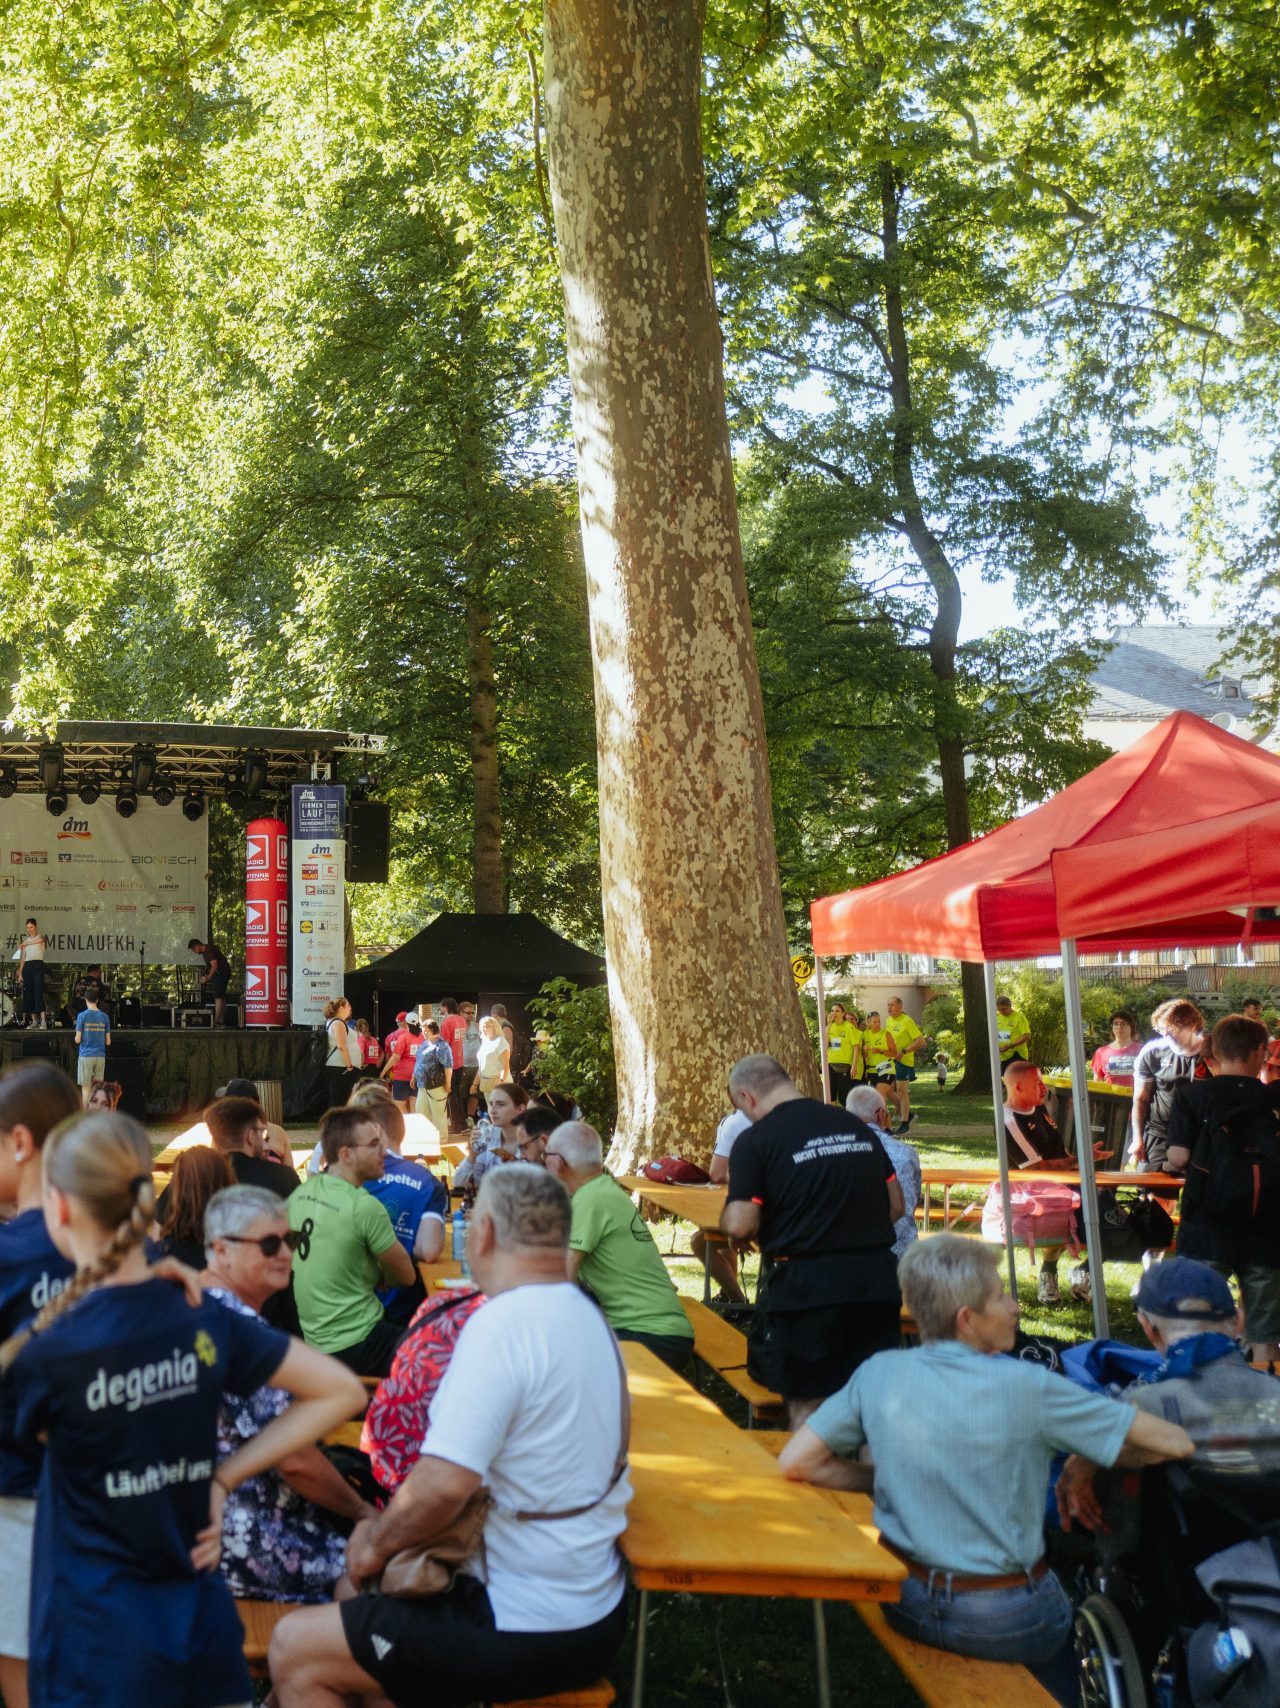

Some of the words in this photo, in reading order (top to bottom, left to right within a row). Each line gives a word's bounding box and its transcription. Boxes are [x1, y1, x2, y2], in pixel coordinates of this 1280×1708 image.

[302, 809, 323, 818] LAUF
[63, 816, 89, 832] dm
[312, 844, 331, 855] dm
[132, 856, 197, 864] BIONTECH
[6, 934, 135, 951] #FMENLAUFKH
[793, 1149, 817, 1164] NICHT
[817, 1142, 873, 1156] STEUERPFLICHTIG
[298, 1217, 314, 1261] 8
[86, 1347, 198, 1412] degenia
[106, 1469, 160, 1498] Läuft
